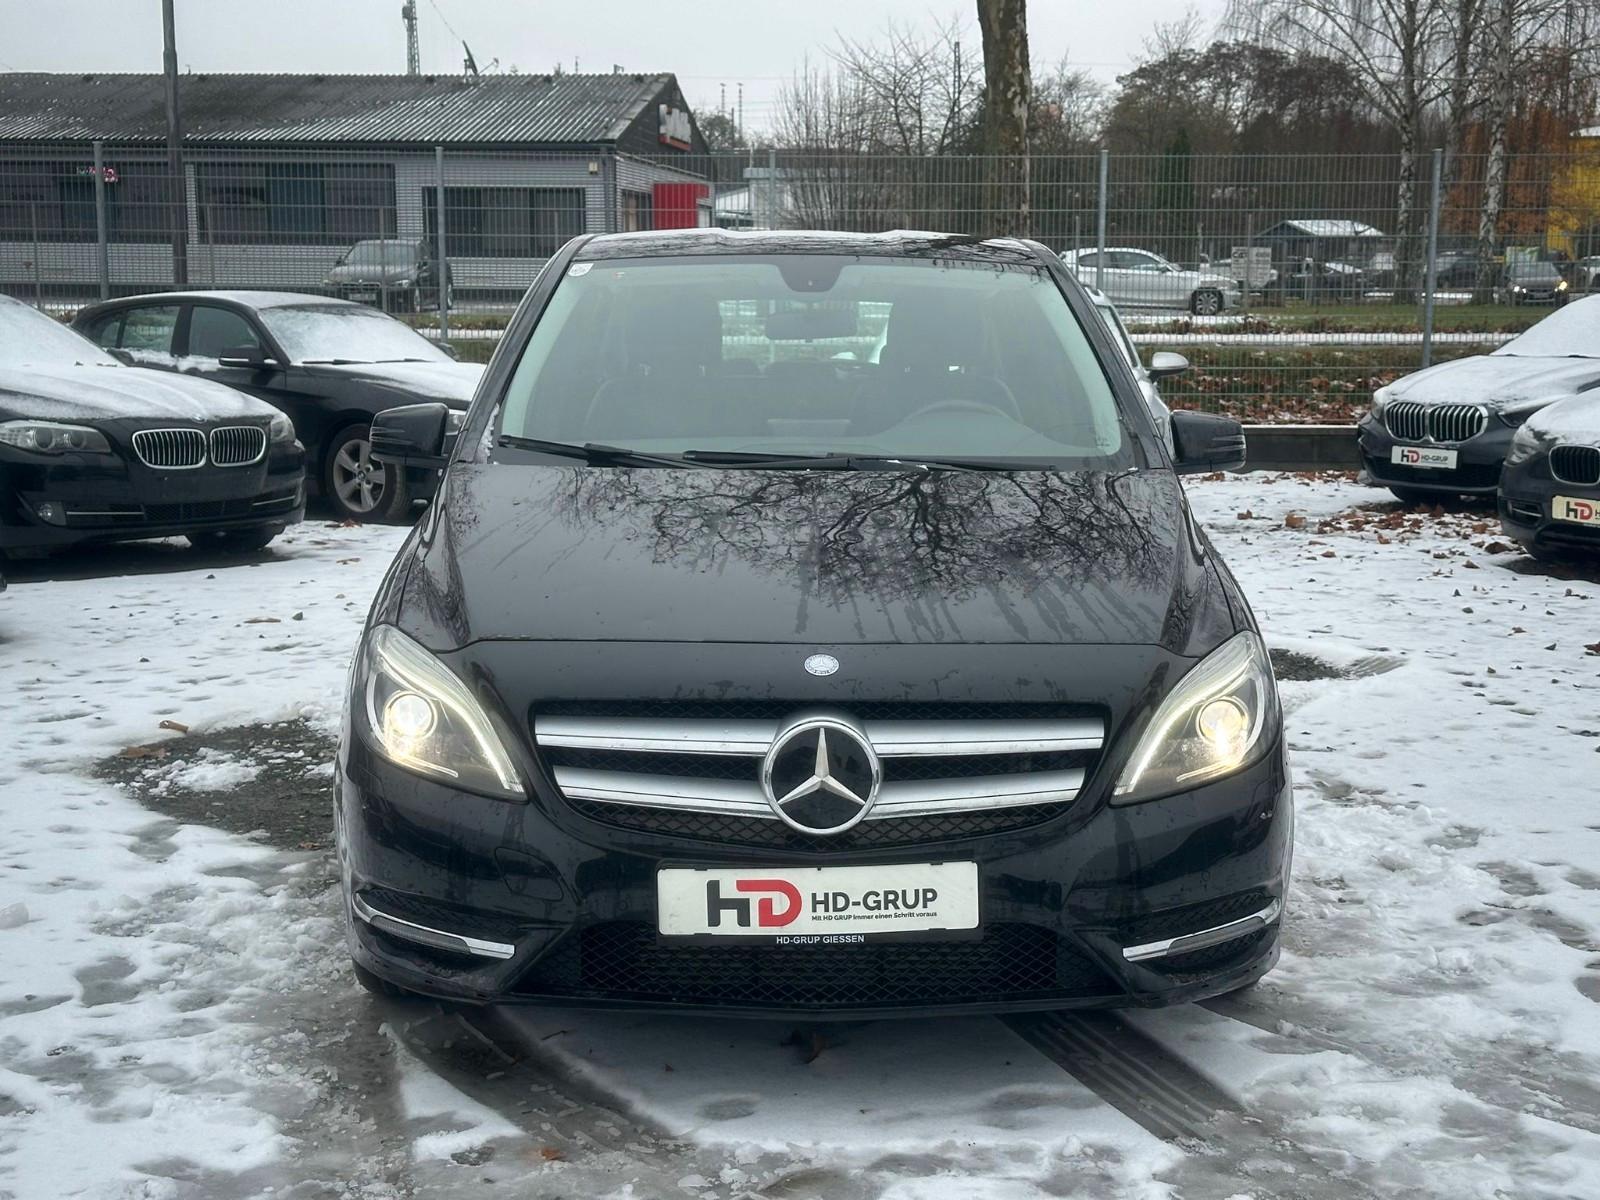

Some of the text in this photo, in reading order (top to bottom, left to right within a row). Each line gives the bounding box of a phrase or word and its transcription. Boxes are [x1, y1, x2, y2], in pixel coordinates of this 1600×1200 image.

[1400, 449, 1420, 463] HD
[1566, 501, 1593, 520] HD
[707, 879, 802, 927] HD
[811, 888, 938, 913] HD-GRUP
[874, 912, 893, 920] einen
[894, 911, 915, 919] Schritt
[776, 934, 865, 945] HD-GRUP GIESSEN
